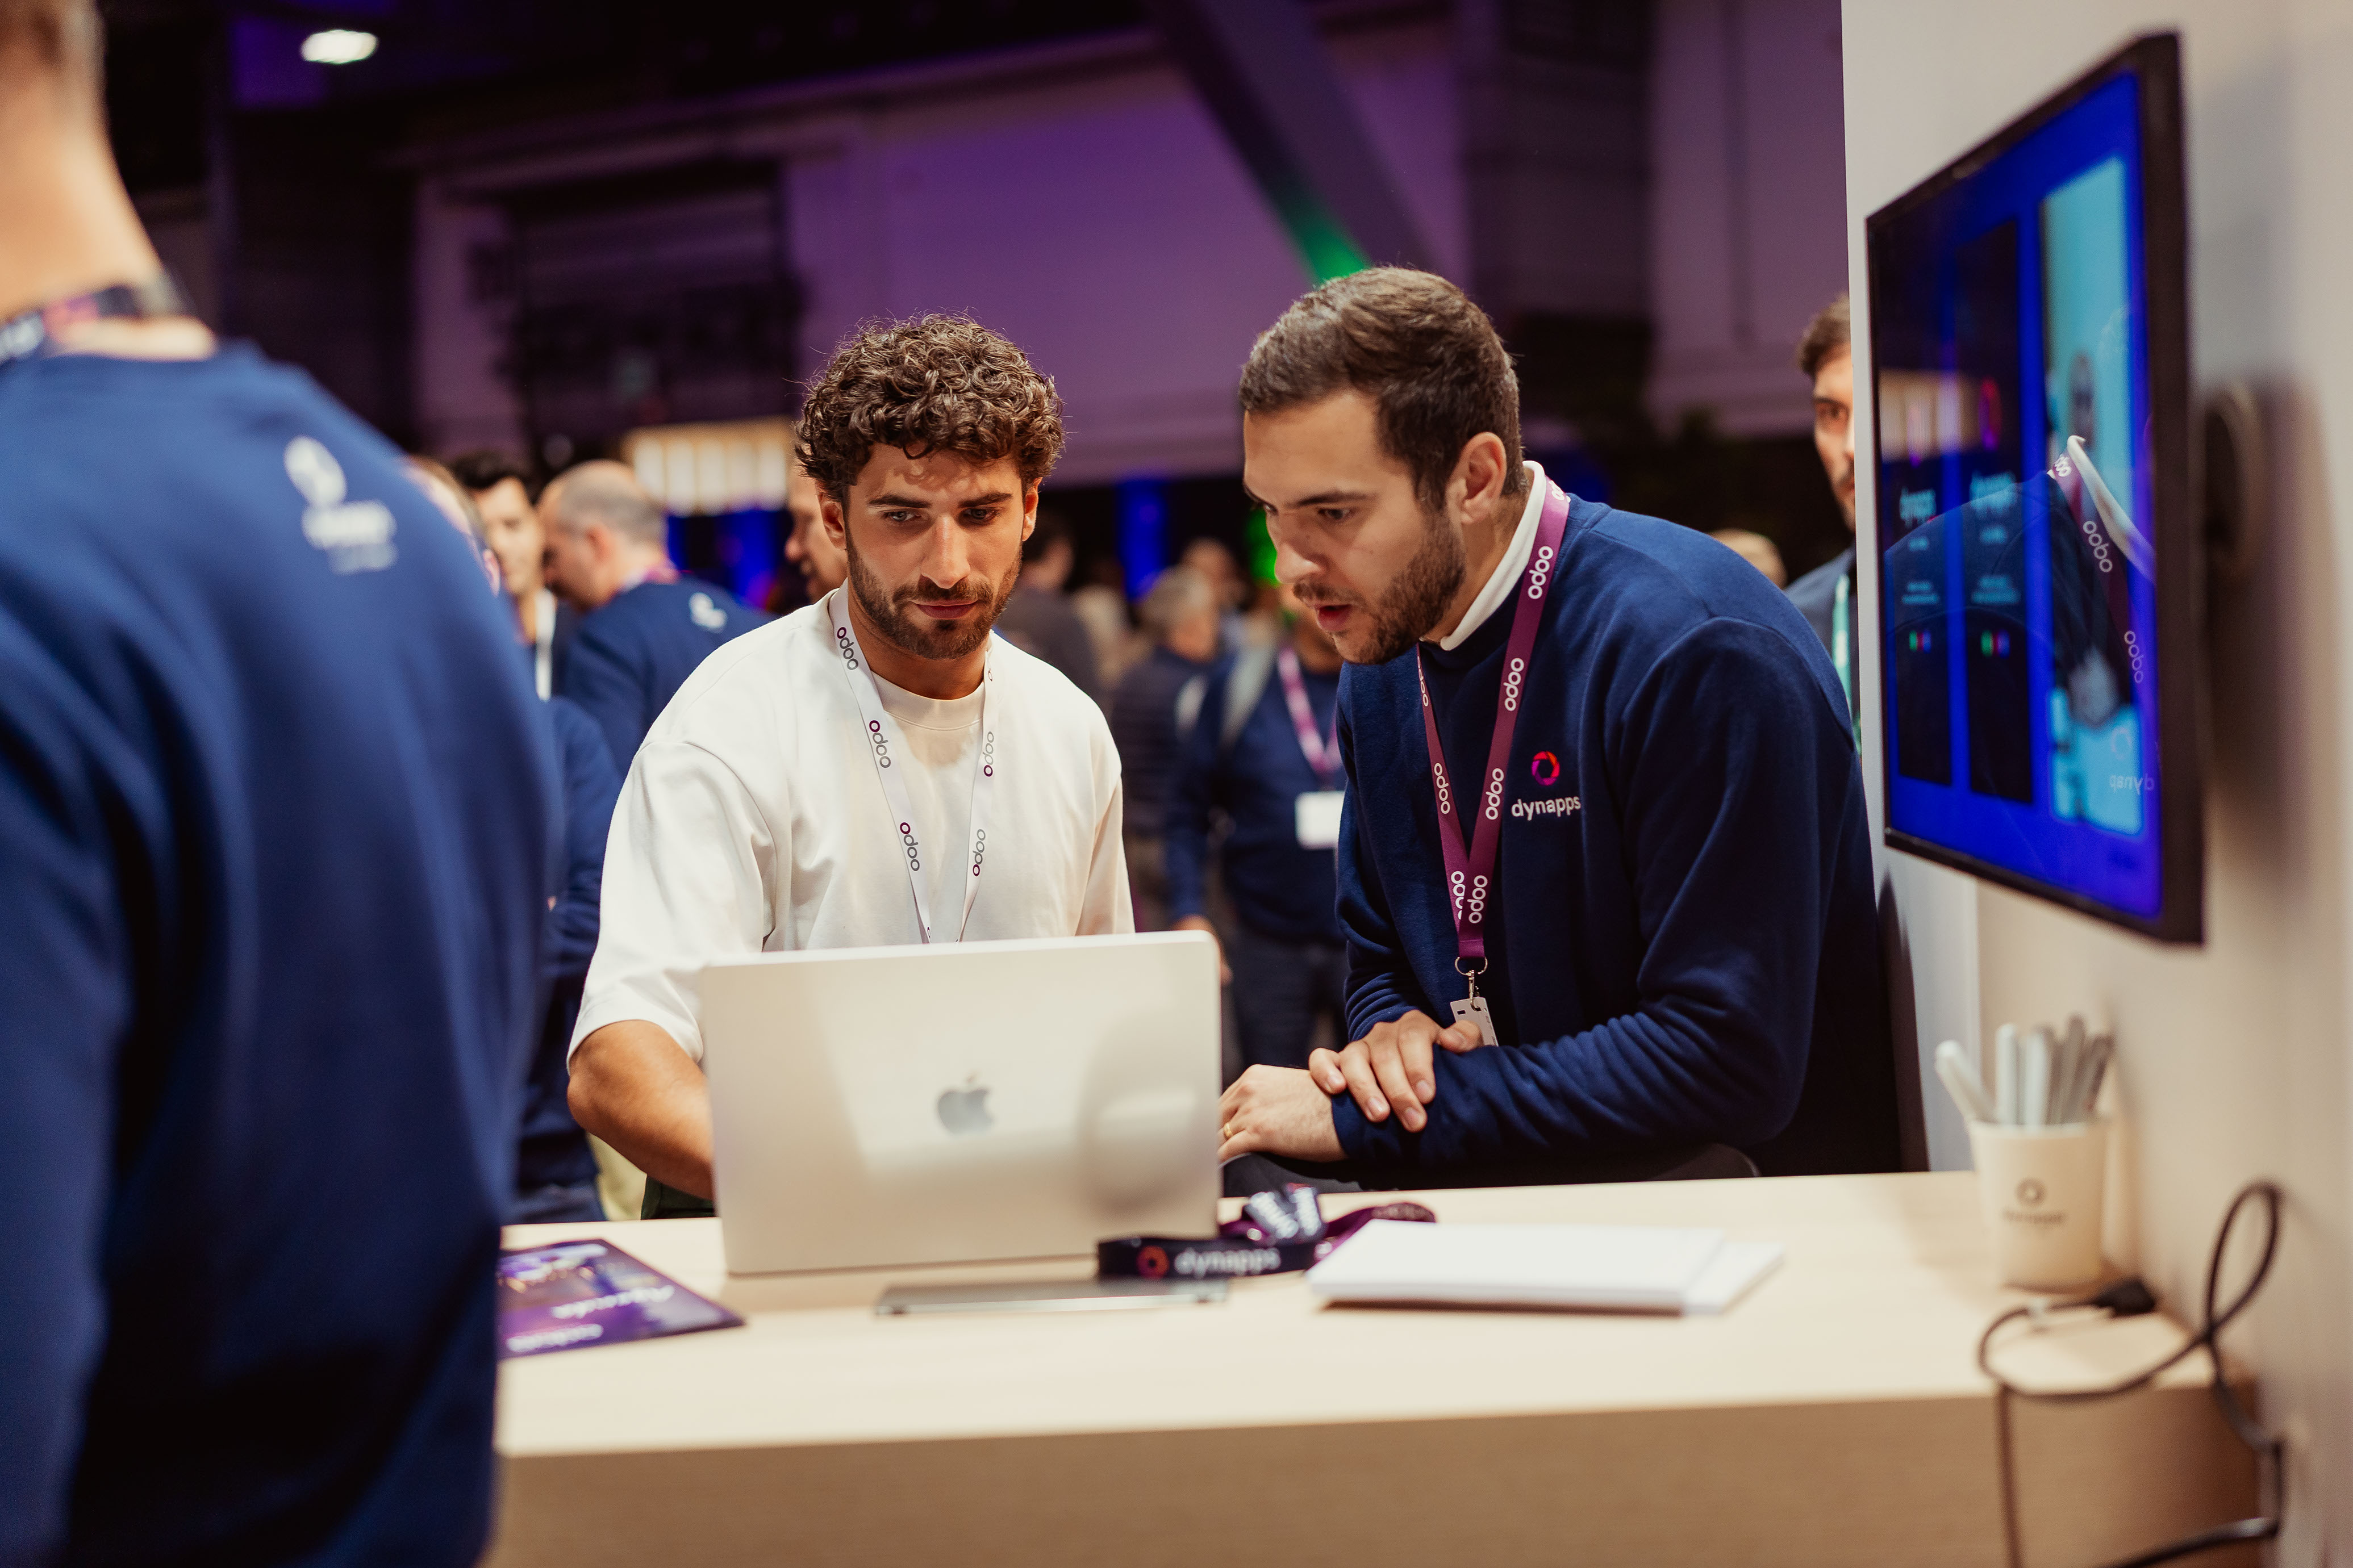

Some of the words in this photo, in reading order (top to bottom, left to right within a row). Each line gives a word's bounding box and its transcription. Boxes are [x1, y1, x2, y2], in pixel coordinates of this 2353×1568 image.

[1528, 546, 1553, 599] odoo
[837, 626, 858, 670] odoo
[1503, 658, 1525, 711] odoo
[869, 720, 891, 768] odoo
[983, 731, 994, 776] odoo
[1434, 763, 1450, 814] odoo
[1485, 768, 1504, 819] odoo
[1511, 796, 1582, 821] dynapps
[899, 822, 920, 871] odoo
[972, 829, 986, 876] odoo
[1467, 875, 1488, 923] odoo
